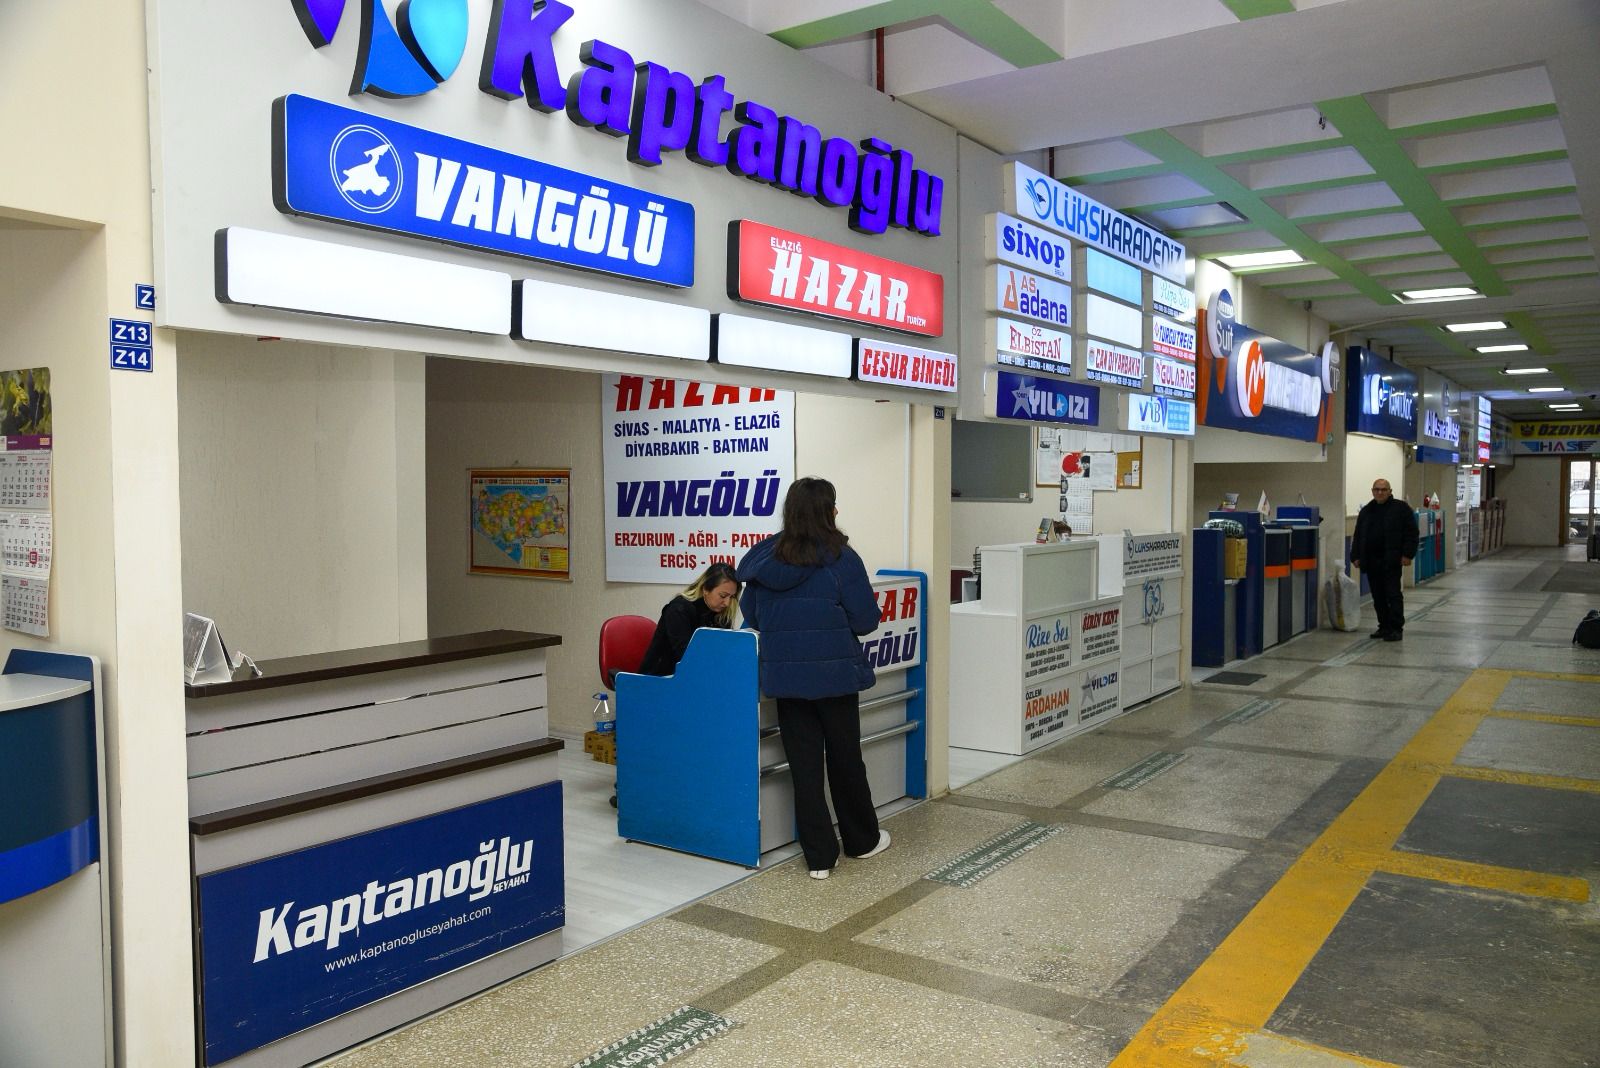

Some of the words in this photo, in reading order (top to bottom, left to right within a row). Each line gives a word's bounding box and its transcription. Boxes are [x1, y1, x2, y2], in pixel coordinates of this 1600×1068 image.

[479, 0, 944, 237] Kaptanoğlu
[414, 151, 669, 268] VANGÖLÜ
[770, 237, 802, 254] ELAZIĞ
[1003, 223, 1065, 268] SİNOP
[140, 289, 153, 306] Z
[768, 247, 909, 323] HAZAR
[1021, 275, 1036, 293] AS
[1020, 289, 1068, 325] adana
[114, 324, 148, 342] Z13
[1009, 325, 1062, 361] ELBİSTAN
[1216, 319, 1234, 352] Suit
[115, 349, 149, 367] Z14
[861, 348, 909, 381] CESUR
[911, 355, 956, 388] BİNGÖL
[1028, 389, 1089, 420] YILDIZI
[614, 420, 650, 438] SİVAS
[662, 417, 721, 435] MALATYA
[734, 410, 780, 431] ELAZIĞ
[625, 440, 700, 458] DİYARBAKIR
[713, 437, 769, 454] BATMAN
[616, 469, 781, 518] VANGÖLÜ
[614, 532, 675, 547] ERZURUM
[687, 530, 718, 548] AĞRI
[660, 553, 697, 571] ERCİŞ
[1025, 623, 1051, 649] Rize
[1053, 618, 1069, 643] Ses
[1025, 688, 1042, 701] ÖZLEM
[1025, 688, 1070, 720] ARDAHAN
[492, 872, 531, 895] SEYAHAT
[252, 836, 534, 964] Kaptanoğlu
[324, 904, 492, 974] www.kaptanogluseyahat.com
